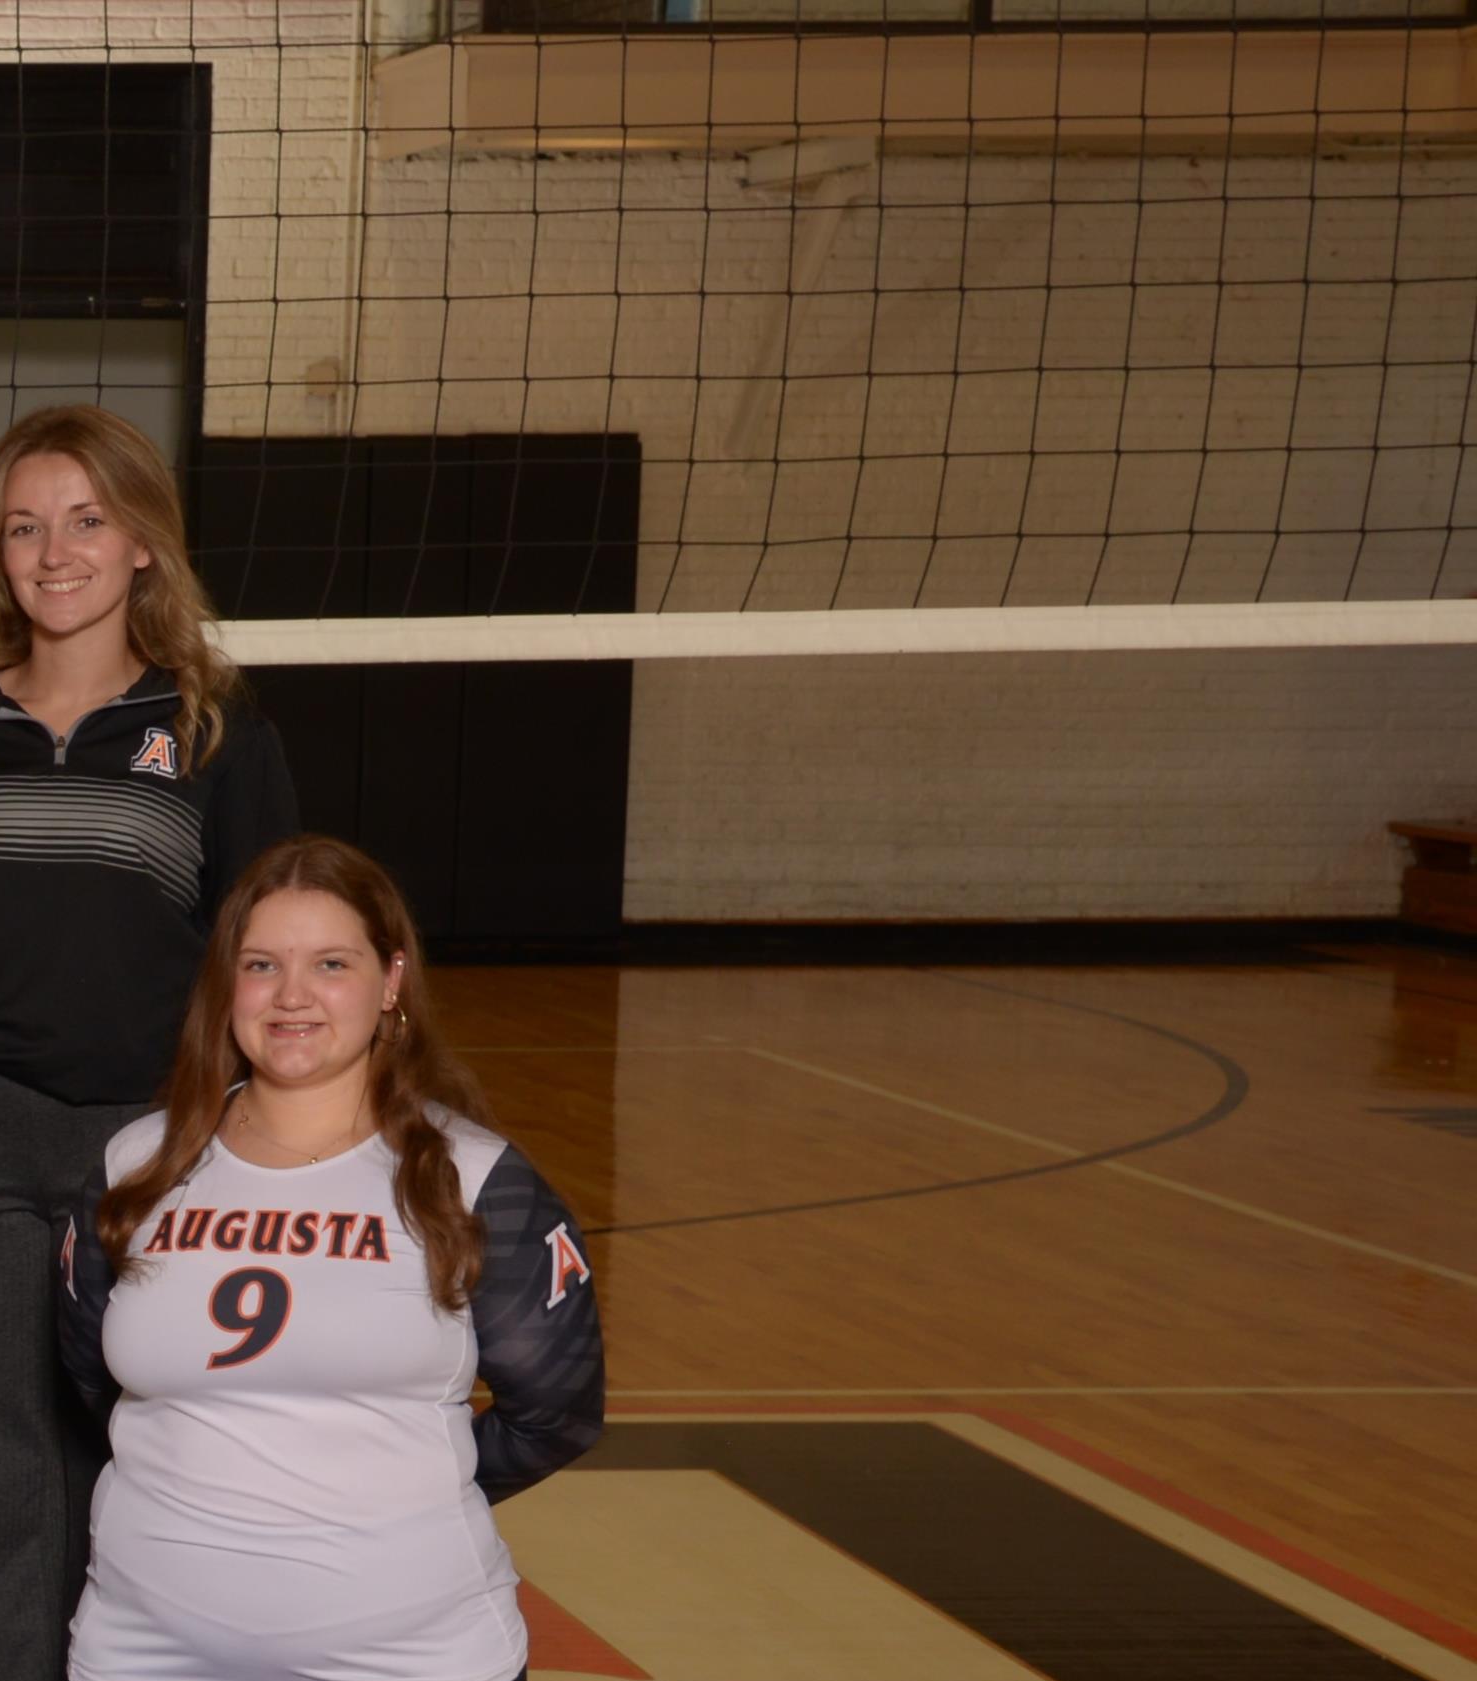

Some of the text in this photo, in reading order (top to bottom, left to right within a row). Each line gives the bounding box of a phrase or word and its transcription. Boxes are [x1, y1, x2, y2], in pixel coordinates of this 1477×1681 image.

[130, 727, 177, 779] A
[144, 1208, 391, 1263] AUGUSTA
[545, 1221, 590, 1310] A
[206, 1266, 292, 1370] 9
